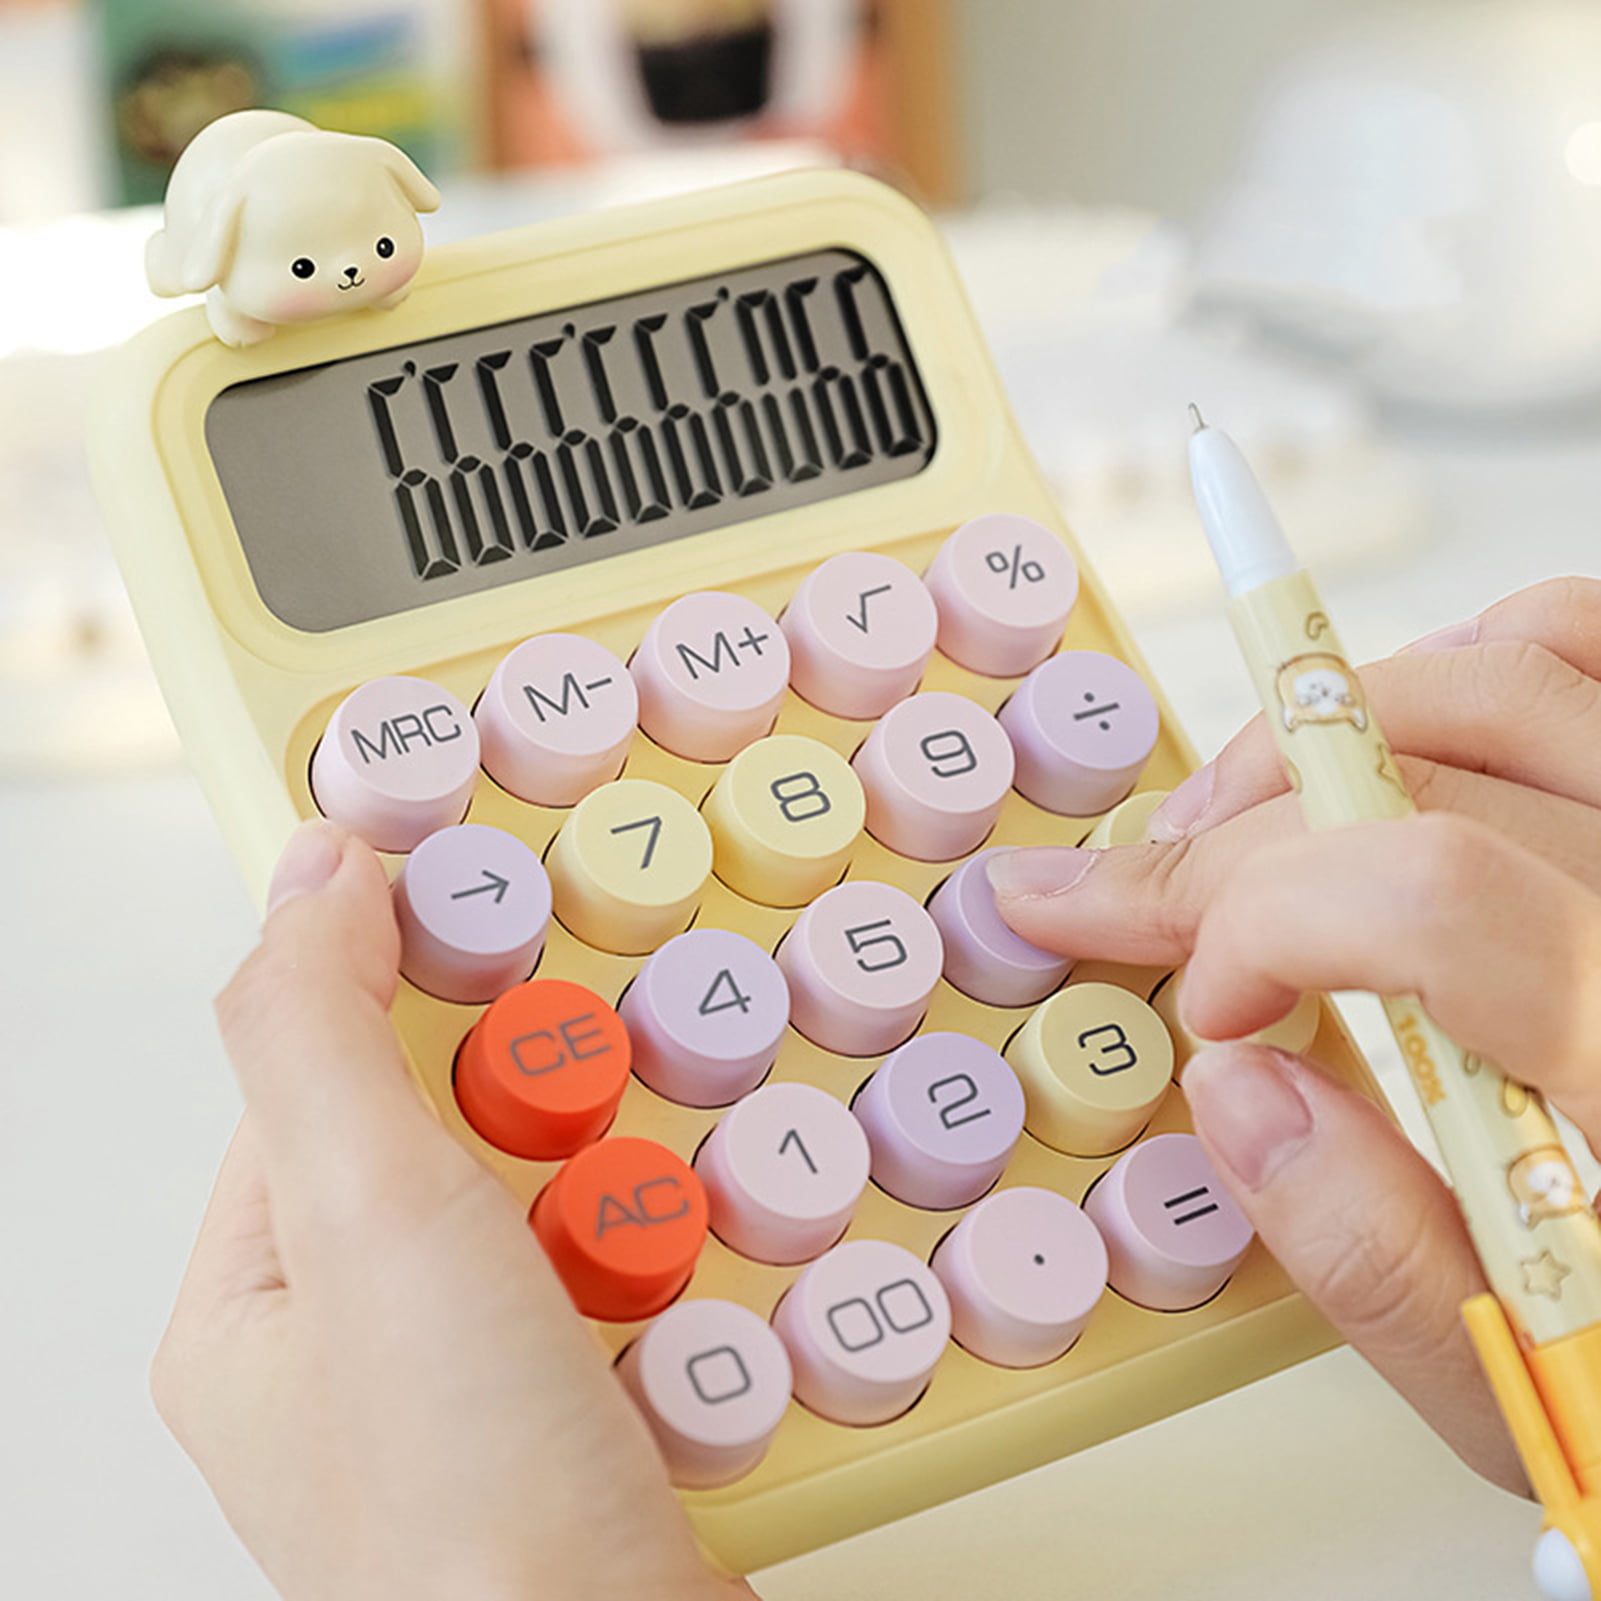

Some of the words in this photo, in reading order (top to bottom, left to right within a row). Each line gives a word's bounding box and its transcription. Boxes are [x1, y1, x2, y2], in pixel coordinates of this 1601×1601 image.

[675, 626, 768, 680] M+
[523, 673, 612, 723] M-
[351, 704, 462, 764] MRC
[920, 730, 977, 778] 9
[770, 772, 831, 823] 8
[610, 816, 662, 870] 7
[844, 919, 908, 973] 5
[698, 969, 751, 1016] 4
[509, 1012, 614, 1077] CE
[1078, 1023, 1137, 1076] 3
[927, 1073, 991, 1130] 2
[778, 1129, 818, 1174] 1
[595, 1176, 690, 1239] AC
[826, 1277, 935, 1354] 00
[686, 1345, 751, 1405] 0
